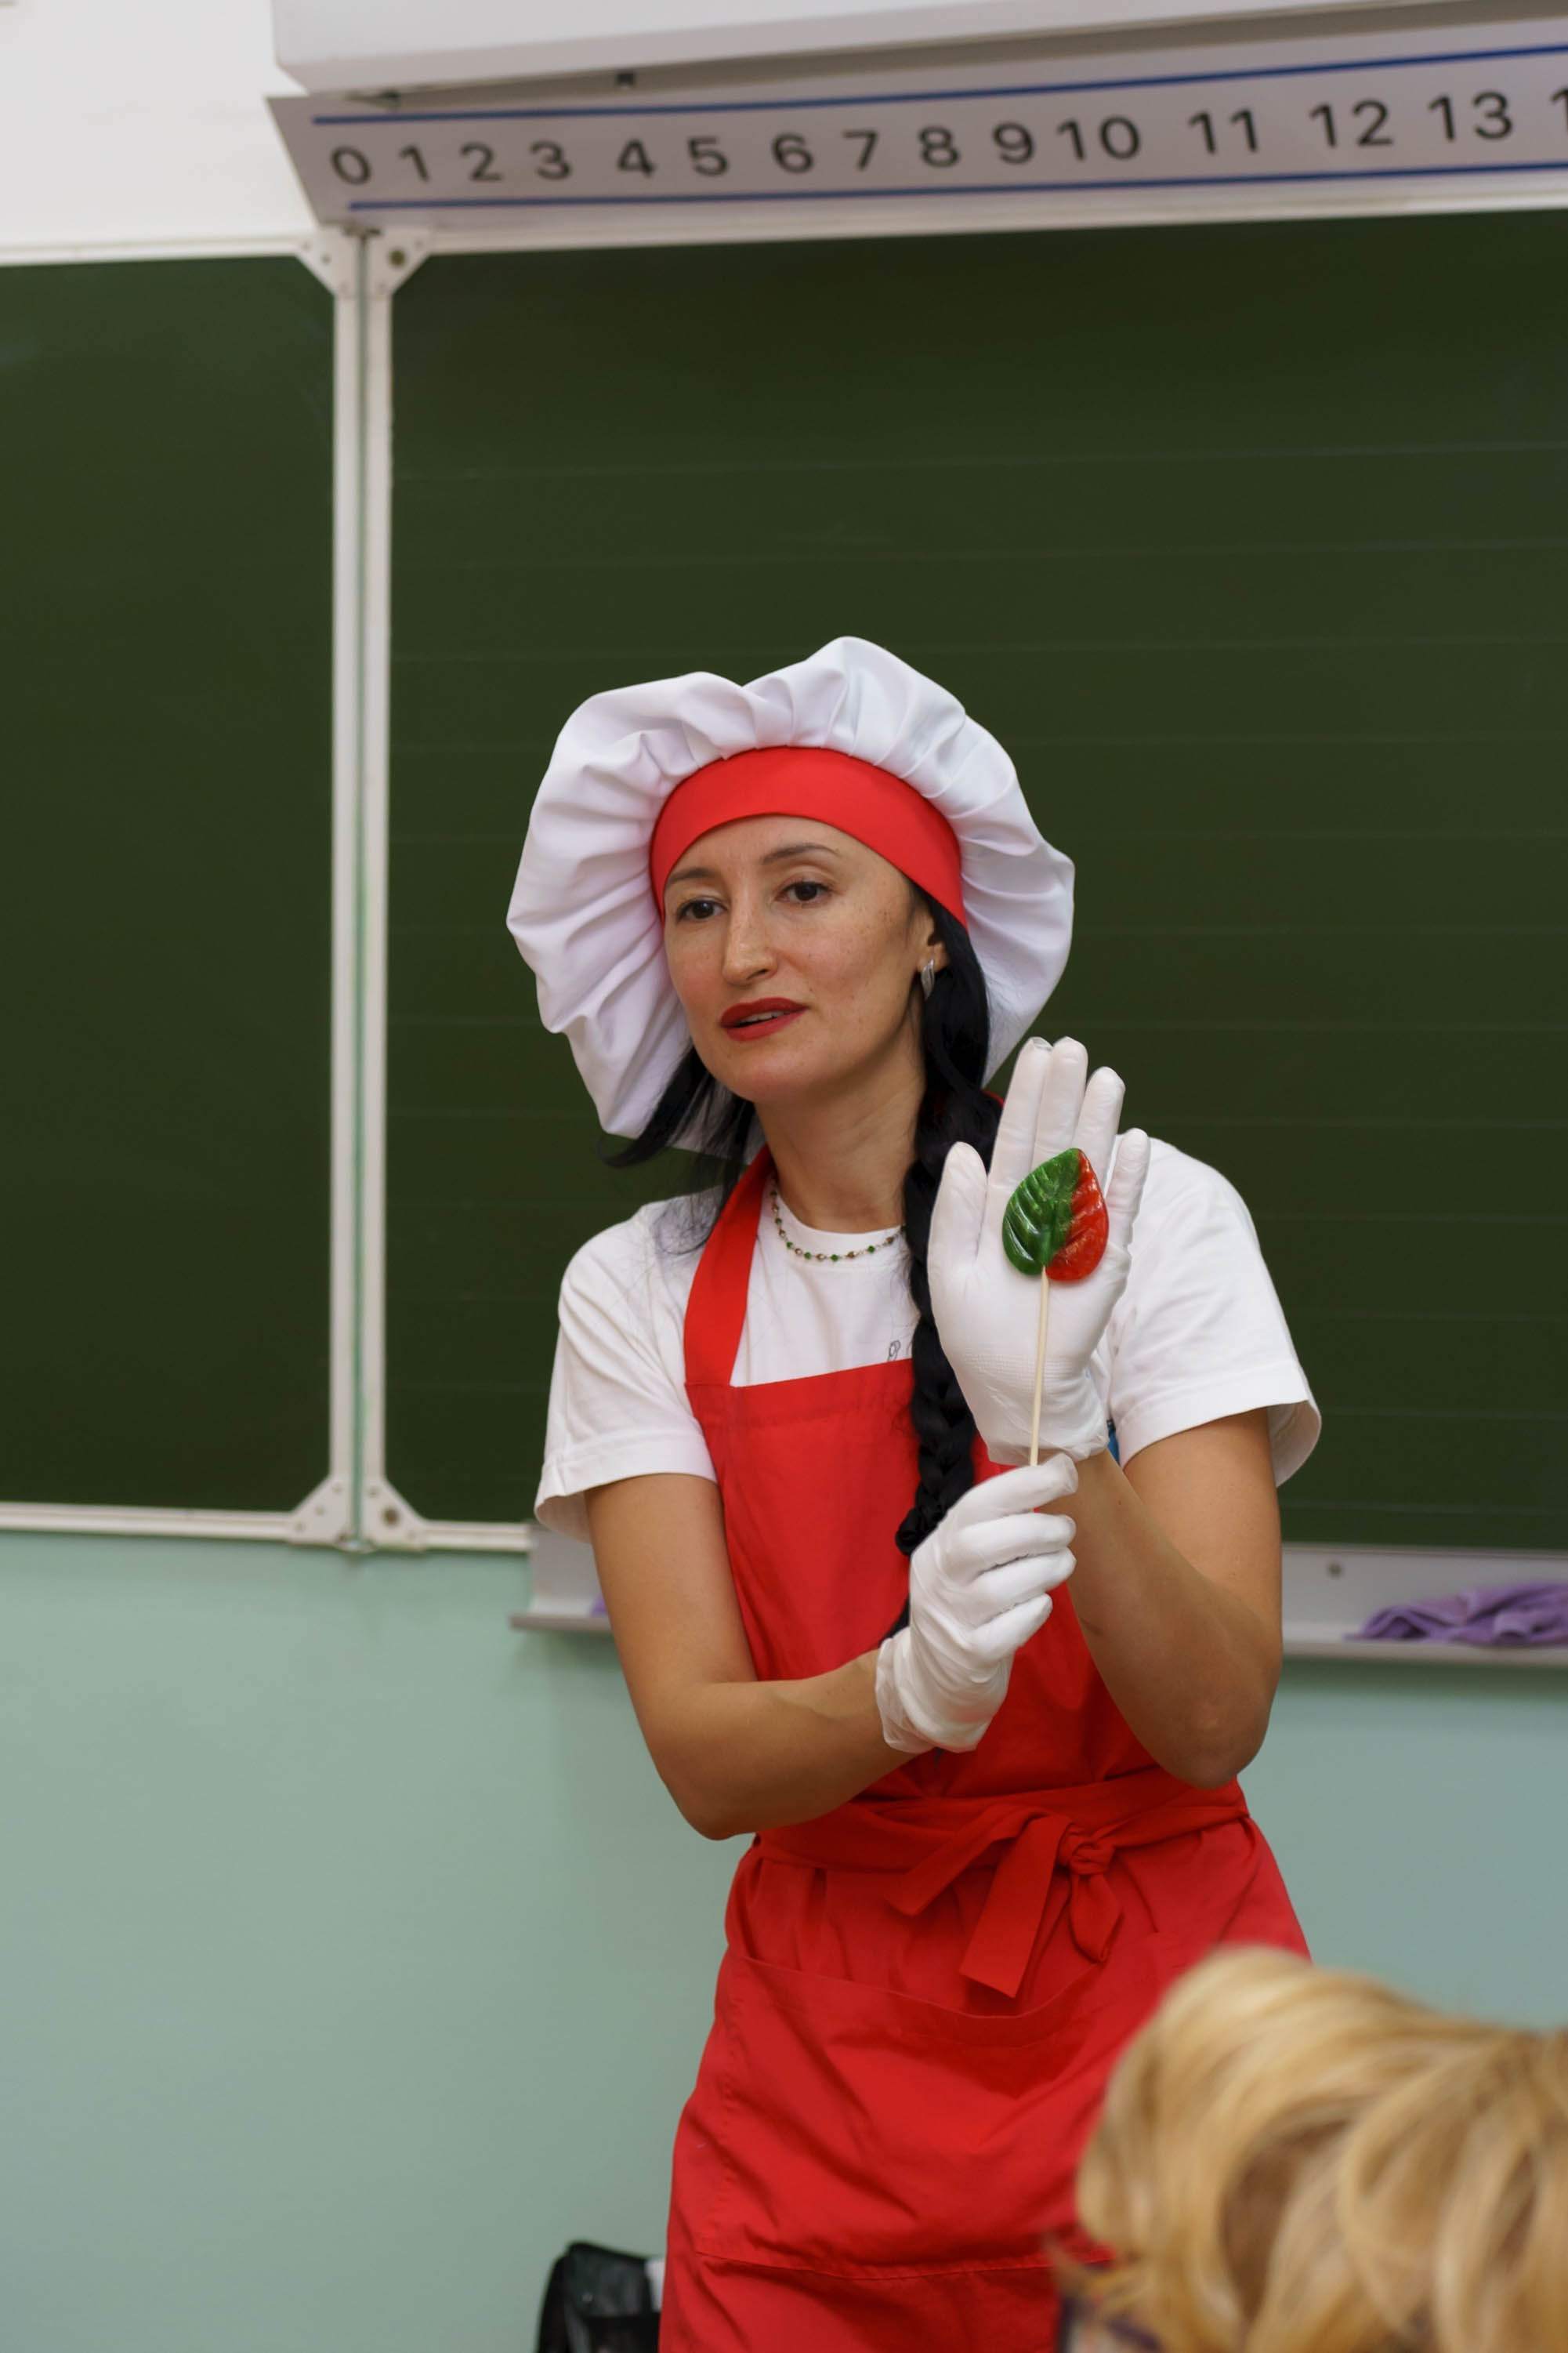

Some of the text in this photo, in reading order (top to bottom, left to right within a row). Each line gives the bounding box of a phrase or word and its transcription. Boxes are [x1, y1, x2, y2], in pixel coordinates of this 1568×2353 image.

[331, 147, 371, 184] 0
[400, 145, 429, 181] 1
[461, 143, 501, 181] 2
[530, 141, 571, 179] 3
[616, 140, 656, 176] 4
[688, 137, 730, 176] 5
[772, 134, 814, 173] 6
[843, 130, 879, 170] 7
[918, 126, 960, 167] 8
[992, 122, 1035, 165] 9
[1057, 117, 1141, 161] 10
[1188, 108, 1258, 154] 11
[1309, 100, 1392, 148] 12
[1428, 91, 1513, 142] 13
